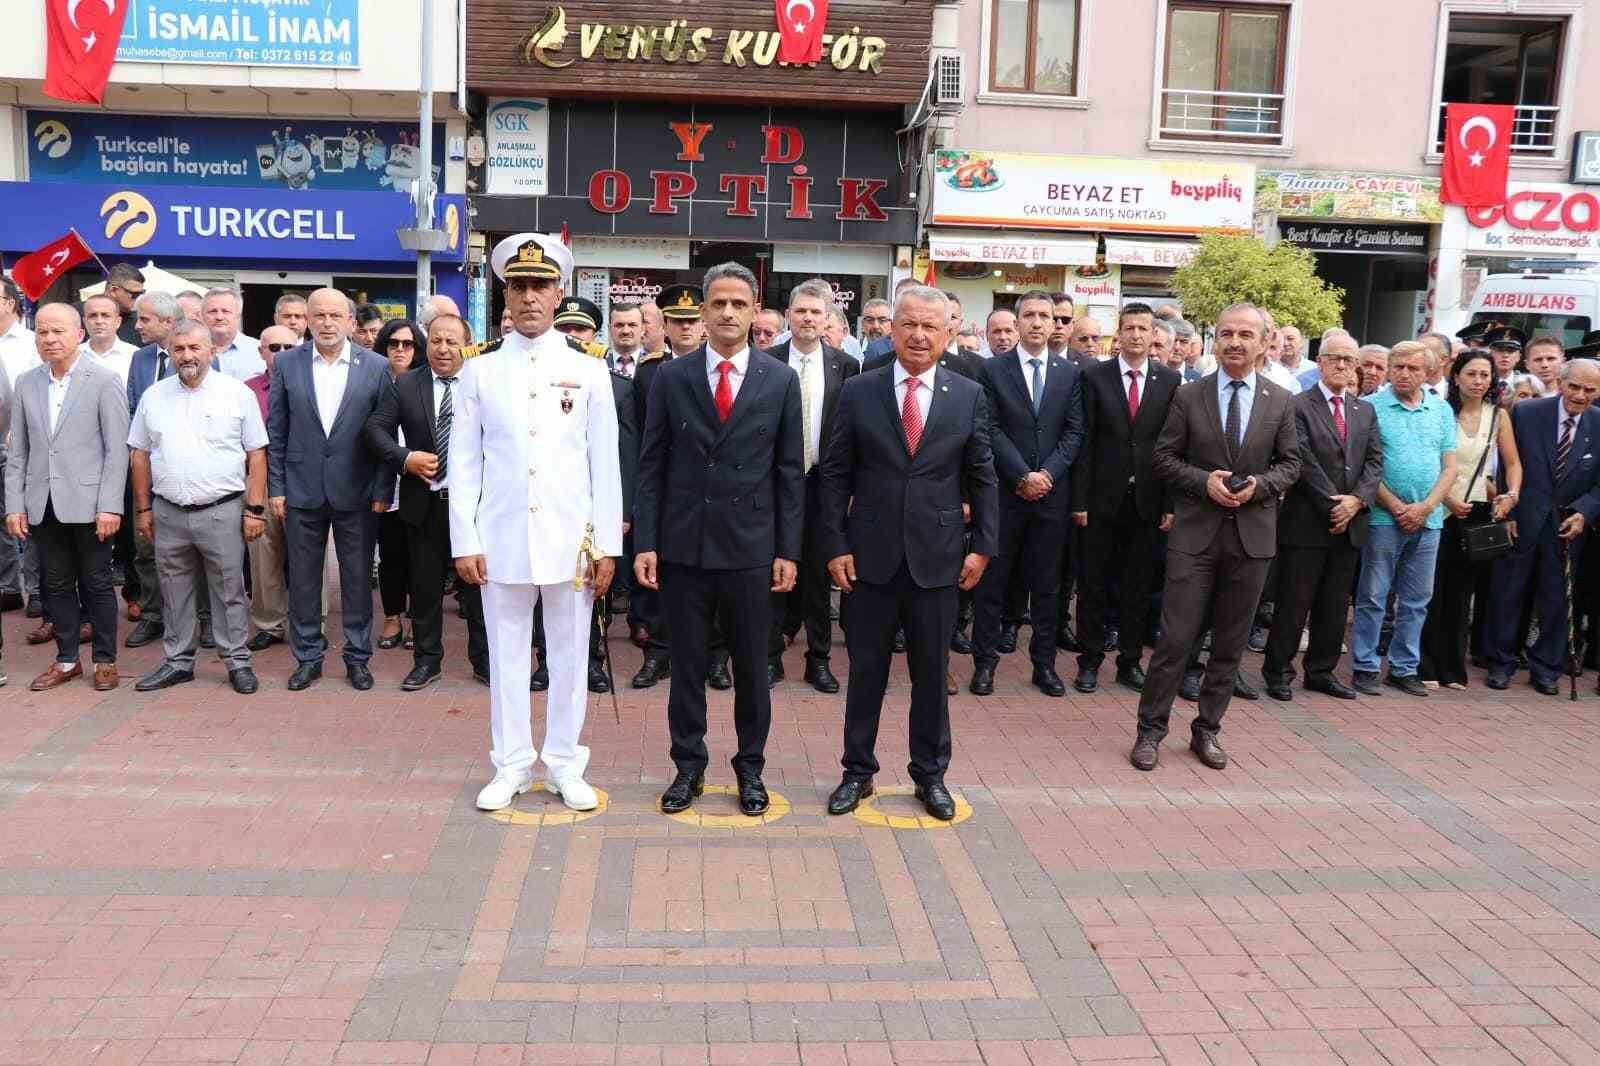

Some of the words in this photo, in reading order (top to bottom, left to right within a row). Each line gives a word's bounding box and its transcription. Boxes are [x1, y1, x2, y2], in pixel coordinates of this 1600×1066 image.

[148, 5, 259, 41] İSMAİL
[268, 9, 351, 44] İNAM
[580, 19, 713, 62] VENÜS
[496, 112, 529, 131] SGK
[94, 135, 190, 154] Turkcell'le
[101, 155, 168, 175] bağlan
[173, 156, 248, 178] hayata!
[588, 164, 889, 222] OPTİK
[1048, 183, 1113, 202] BEYAZ
[1120, 187, 1144, 204] ET
[1170, 179, 1242, 203] beypiliç
[170, 205, 356, 240] TURKCELL
[1023, 204, 1080, 217] ÇAYCUMA
[1084, 207, 1114, 219] SATIŞ
[1118, 208, 1167, 220] NOKTASI
[1287, 227, 1309, 241] Best
[1344, 229, 1353, 243] &
[982, 245, 1027, 260] BEYAZ
[1032, 247, 1049, 260] ET
[1482, 293, 1577, 311] AMBULANS
